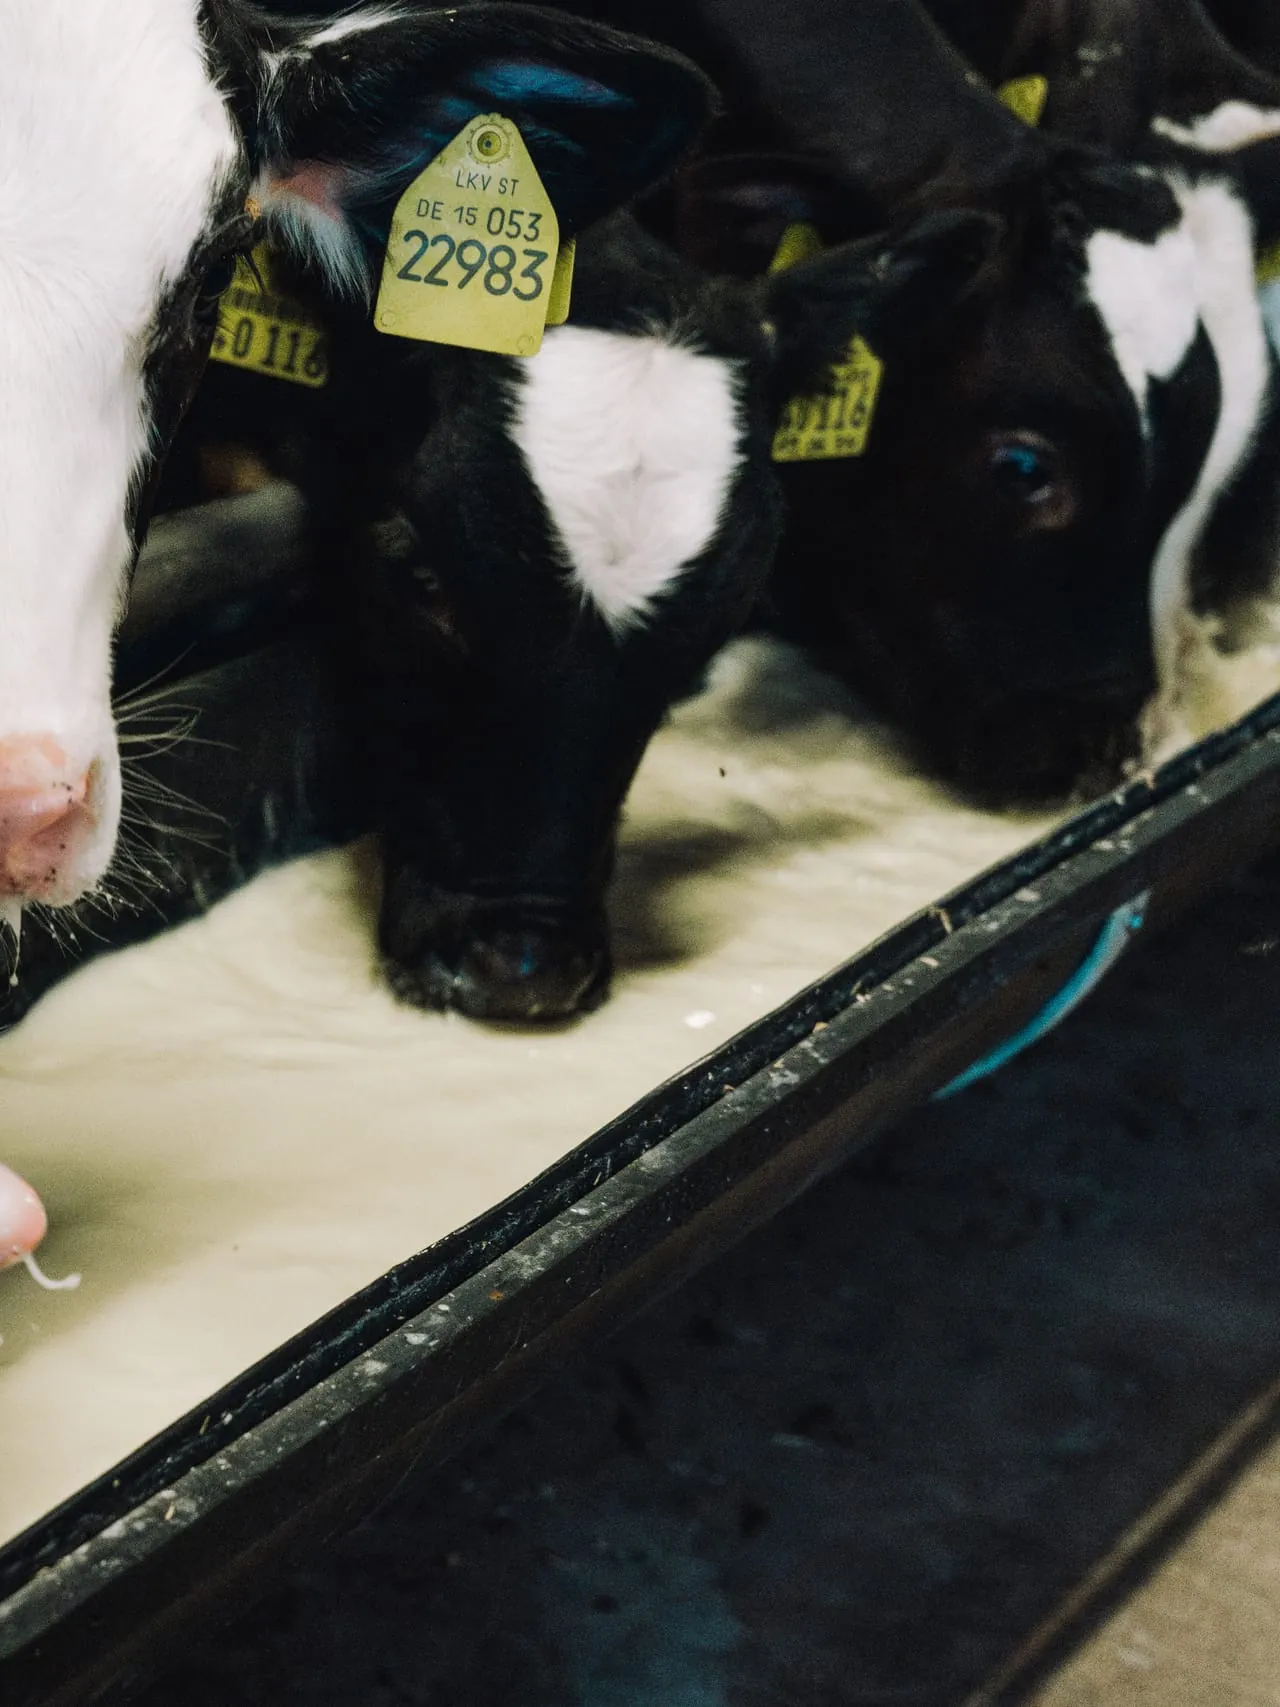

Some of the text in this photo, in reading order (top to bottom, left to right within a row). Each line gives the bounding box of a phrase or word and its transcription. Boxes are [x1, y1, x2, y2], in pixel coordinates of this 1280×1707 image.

[455, 169, 519, 196] LKV ST
[416, 198, 543, 242] DE 15 053
[396, 228, 549, 301] 22983
[213, 316, 328, 378] 0116
